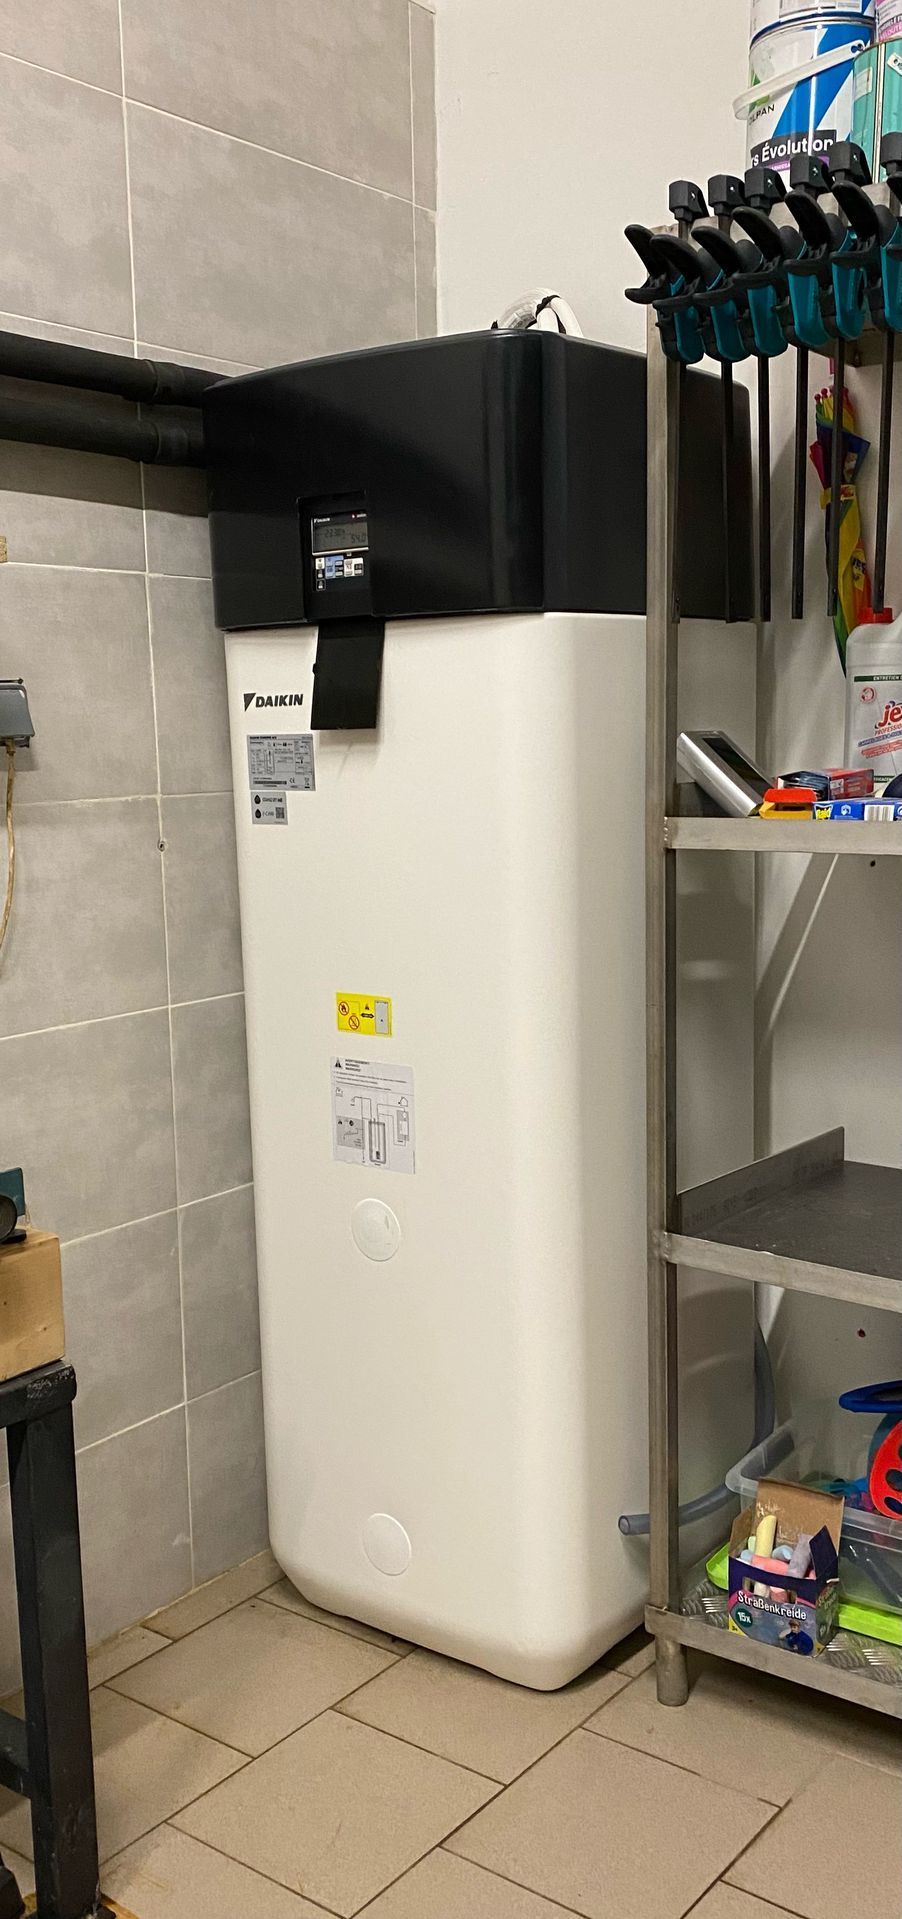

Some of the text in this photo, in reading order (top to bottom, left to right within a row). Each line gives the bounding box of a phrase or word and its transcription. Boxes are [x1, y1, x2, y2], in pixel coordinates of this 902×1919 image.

[762, 138, 834, 163] Évolution
[256, 693, 304, 708] DAIKIN
[878, 703, 902, 728] je
[737, 1590, 807, 1620] Straßenkreide
[737, 1611, 752, 1624] 15x
